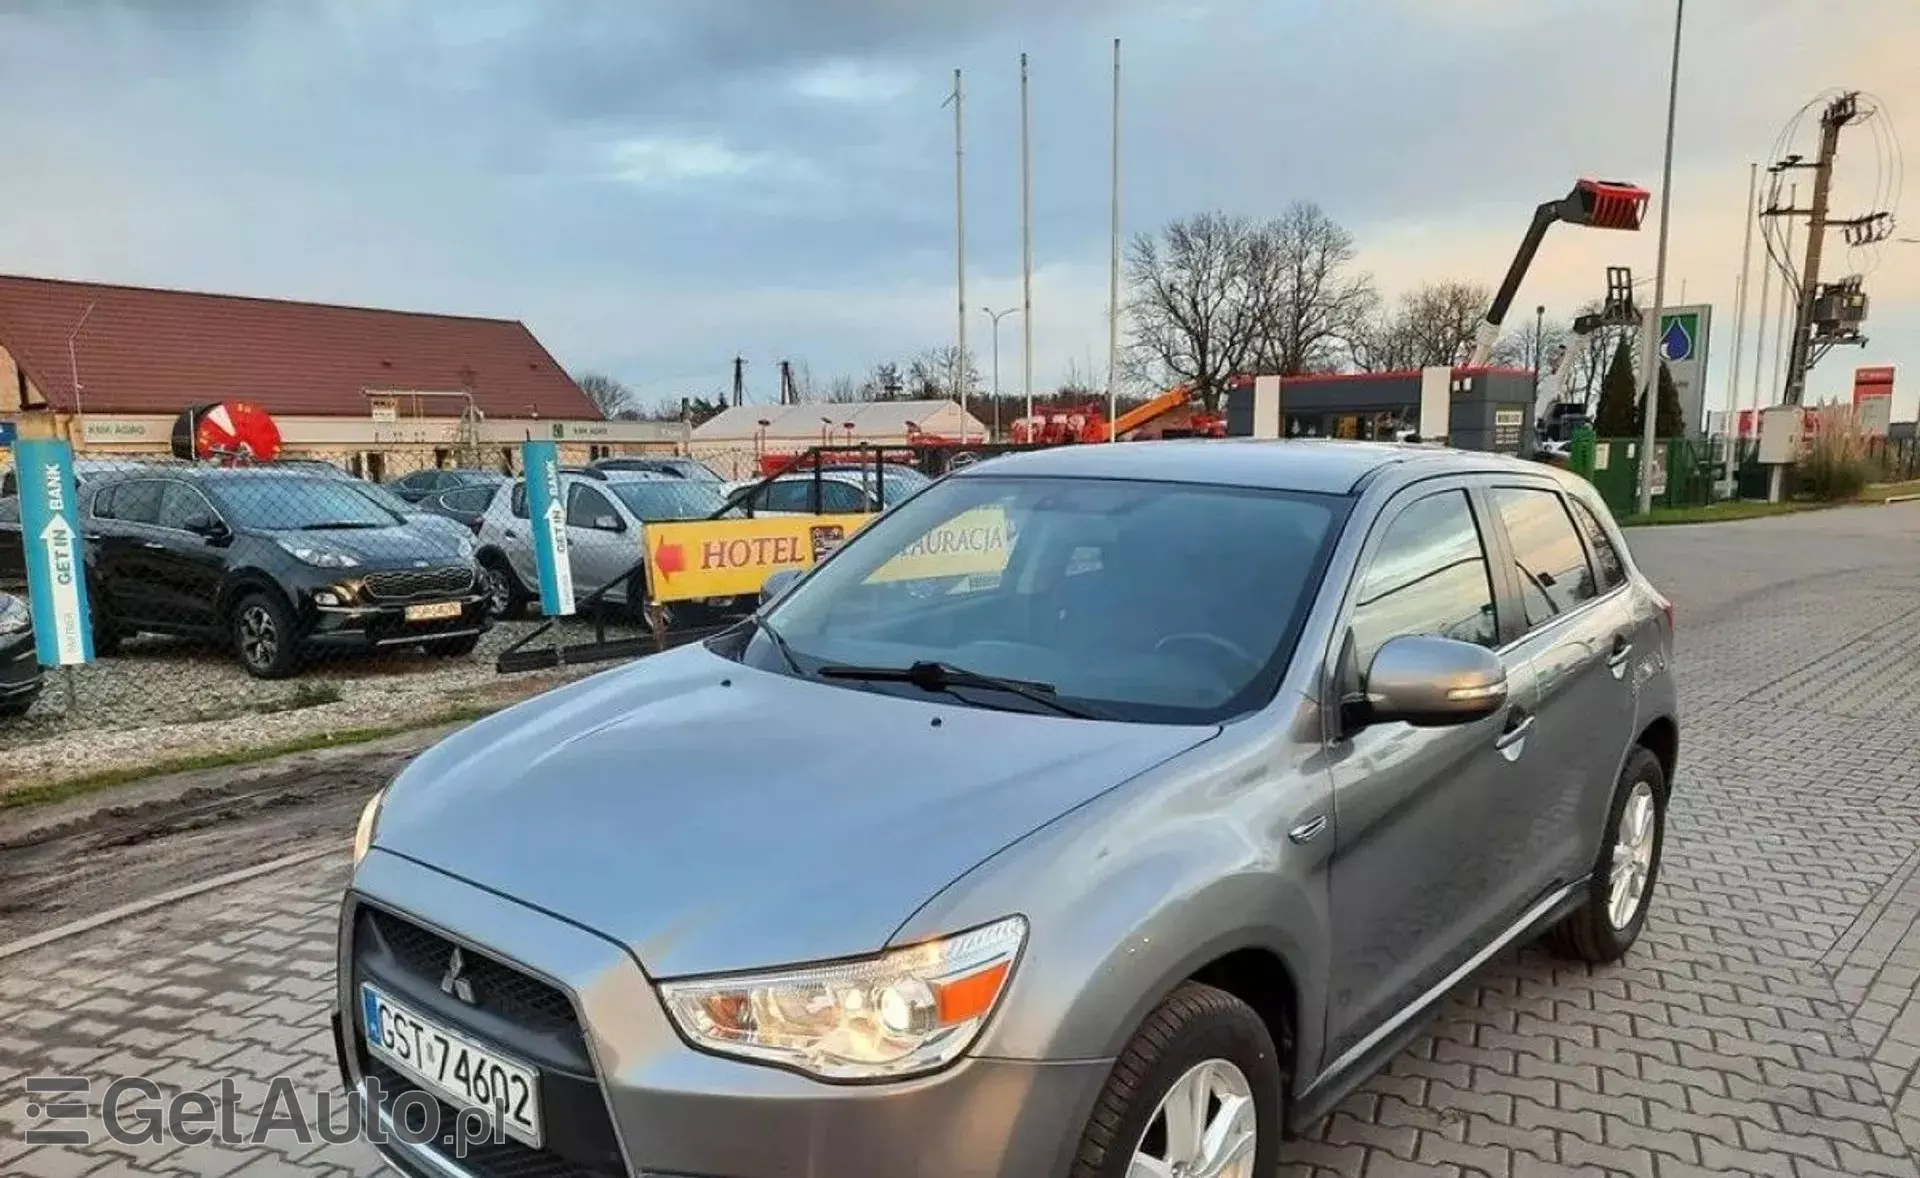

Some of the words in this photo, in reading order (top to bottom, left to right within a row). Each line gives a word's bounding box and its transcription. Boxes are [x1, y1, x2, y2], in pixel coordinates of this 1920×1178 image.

[45, 463, 64, 511] BANK
[545, 460, 558, 497] BANK
[552, 509, 564, 524] IN
[53, 529, 67, 547] IN
[555, 527, 567, 553] GET
[701, 535, 805, 570] HOTEL
[907, 525, 1004, 556] AURACJA
[55, 550, 71, 586] GET
[378, 1004, 424, 1070] GST
[432, 1034, 533, 1128] 74602
